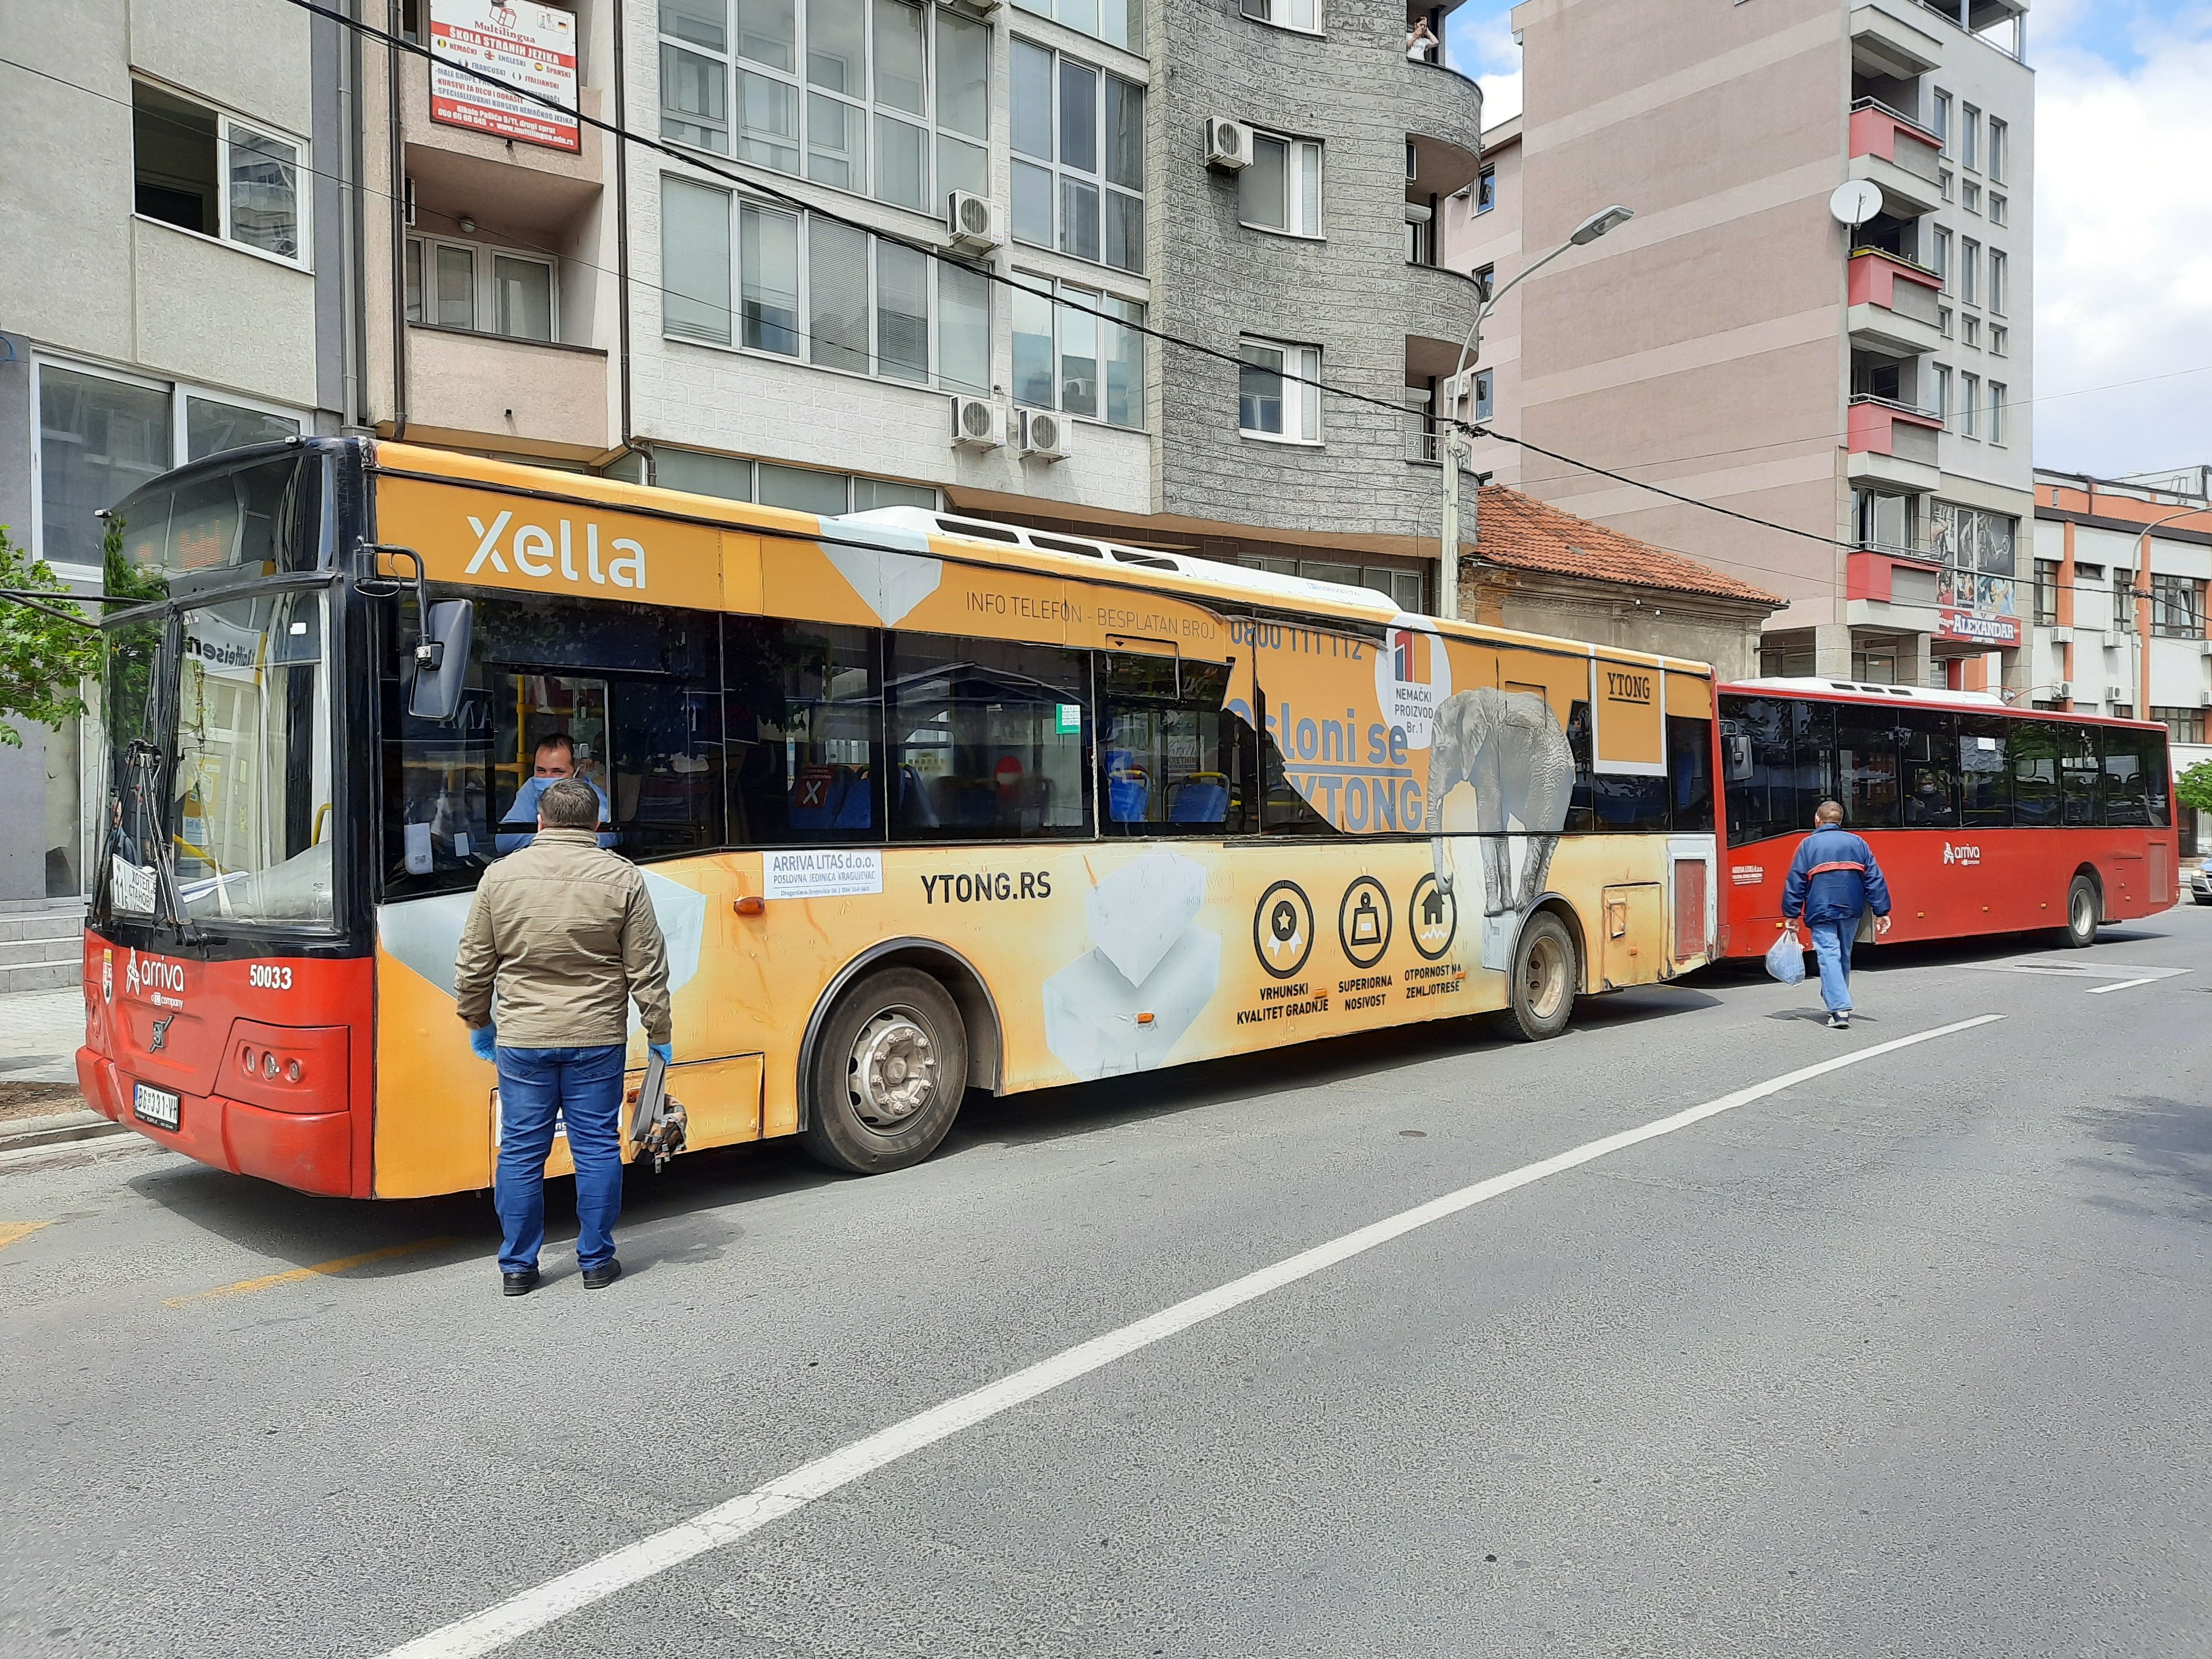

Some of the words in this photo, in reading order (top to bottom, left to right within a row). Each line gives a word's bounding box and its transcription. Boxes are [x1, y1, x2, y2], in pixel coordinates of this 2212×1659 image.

[474, 20, 536, 44] Multilingua
[449, 26, 482, 44] ŠKOLA
[483, 38, 526, 56] STRANIH
[528, 48, 560, 65] JEZIKA
[449, 43, 477, 55] NEMAČKI
[472, 62, 505, 76] FRANCUSKI
[498, 54, 526, 67] ENGLESKI
[546, 66, 571, 78] ŠPANSKI
[475, 87, 492, 96] DECU
[525, 75, 559, 90] ITALIJANSKI
[492, 100, 518, 109] KURSEVI
[520, 106, 553, 120] NEMAČKOG
[555, 114, 573, 124] JEZIKA
[463, 510, 646, 589] Xella
[967, 591, 1006, 614] INFO
[1010, 596, 1083, 624] TELEFON
[1097, 612, 1178, 636] BESPLATAN
[1182, 619, 1215, 641] BROJ
[1230, 620, 1282, 650] 0800
[1288, 627, 1321, 655] 111
[1328, 632, 1362, 660] 112
[1953, 614, 2014, 640] ALEXANDAR
[1396, 687, 1432, 703] NEMAČKI
[1607, 672, 1651, 700] YTONG
[1395, 704, 1433, 719] PROIZVOD
[1367, 723, 1408, 765] se
[1954, 843, 1980, 859] arriva
[773, 855, 815, 872] ARRIVA
[816, 854, 844, 869] LITAS
[846, 853, 874, 869] d.o.o.
[774, 874, 807, 884] POSLOVNA
[809, 872, 836, 883] JEDINICA
[838, 871, 875, 881] KRAGUJEVAC
[921, 872, 1051, 905] YTONG.RS
[141, 954, 184, 992] arriva
[249, 964, 293, 990] 50033
[1404, 965, 1449, 982] OTPORNOST
[1451, 963, 1463, 975] NA
[1260, 983, 1309, 1001] VRHUNSKI
[1338, 975, 1393, 994] SUPERIORNA
[1406, 980, 1460, 999] ZEMLJOTRESE
[161, 996, 184, 1010] company
[1344, 994, 1386, 1011] NOSIVOST
[1237, 1005, 1284, 1026] KVALITET
[1285, 999, 1329, 1018] GRADNJE
[139, 1087, 147, 1109] BG
